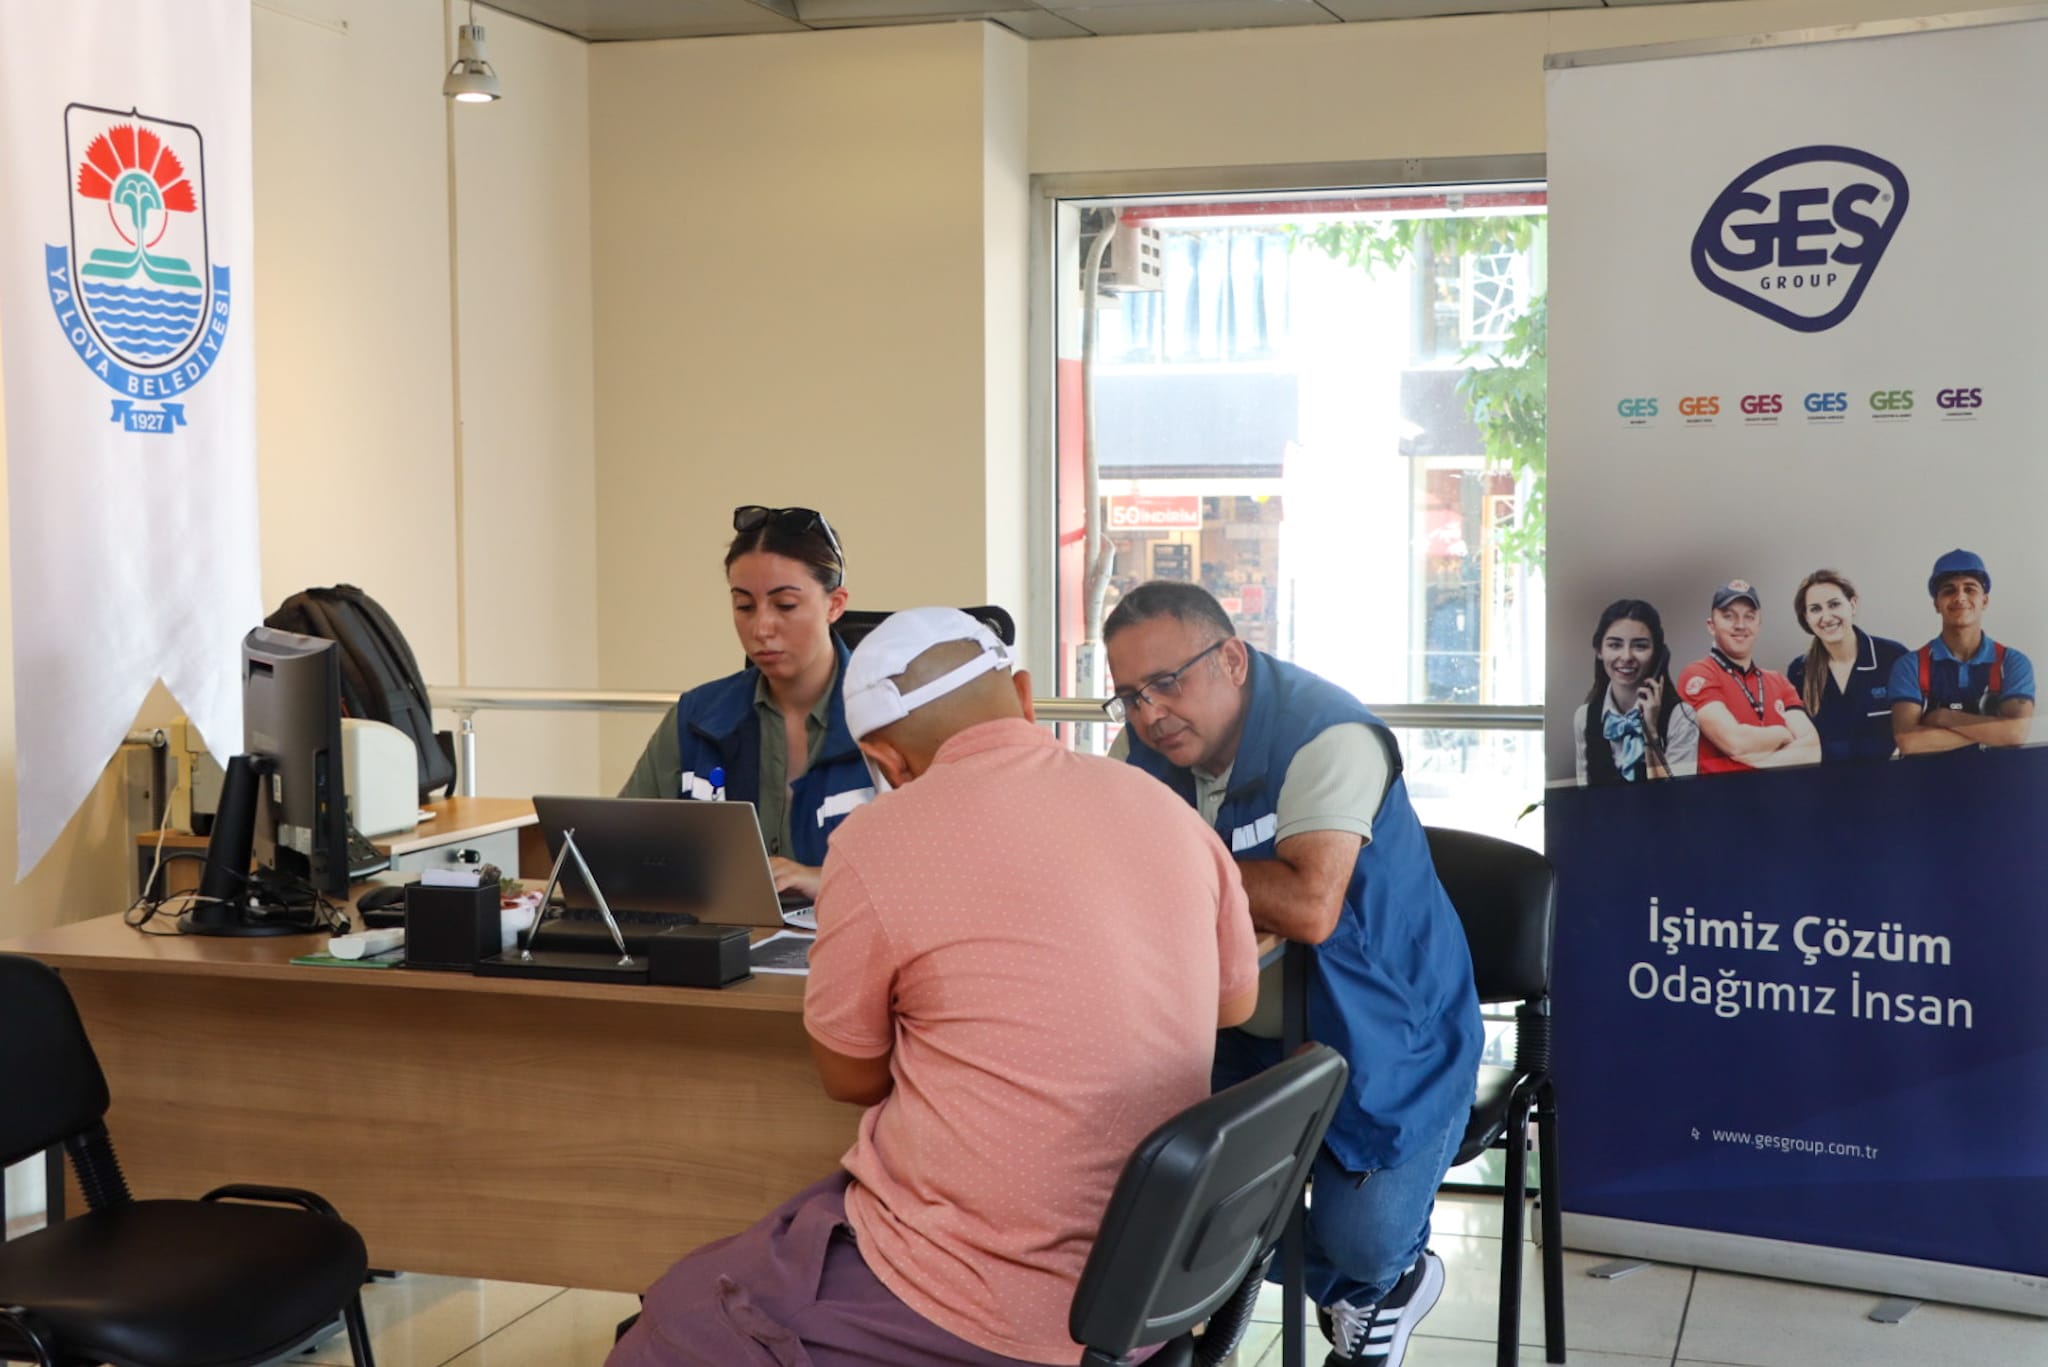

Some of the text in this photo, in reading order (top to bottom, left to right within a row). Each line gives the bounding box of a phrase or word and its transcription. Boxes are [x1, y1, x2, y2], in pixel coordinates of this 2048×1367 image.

[1703, 183, 1881, 272] GES
[1760, 273, 1837, 290] GROUP
[50, 266, 230, 397] YALOVA BELEDİYESİ
[1617, 397, 1659, 418] GES
[1678, 396, 1721, 416] GES
[1740, 394, 1783, 415] GES
[1804, 392, 1848, 413] GES
[1869, 390, 1914, 411] GES
[1936, 387, 1983, 410] GES
[130, 413, 165, 432] 1927
[1649, 896, 1952, 966] İşimiz Çözüm
[1628, 961, 1974, 1029] Odağımız İnsan
[1712, 1127, 1879, 1160] www.gesgroup.com.tr
